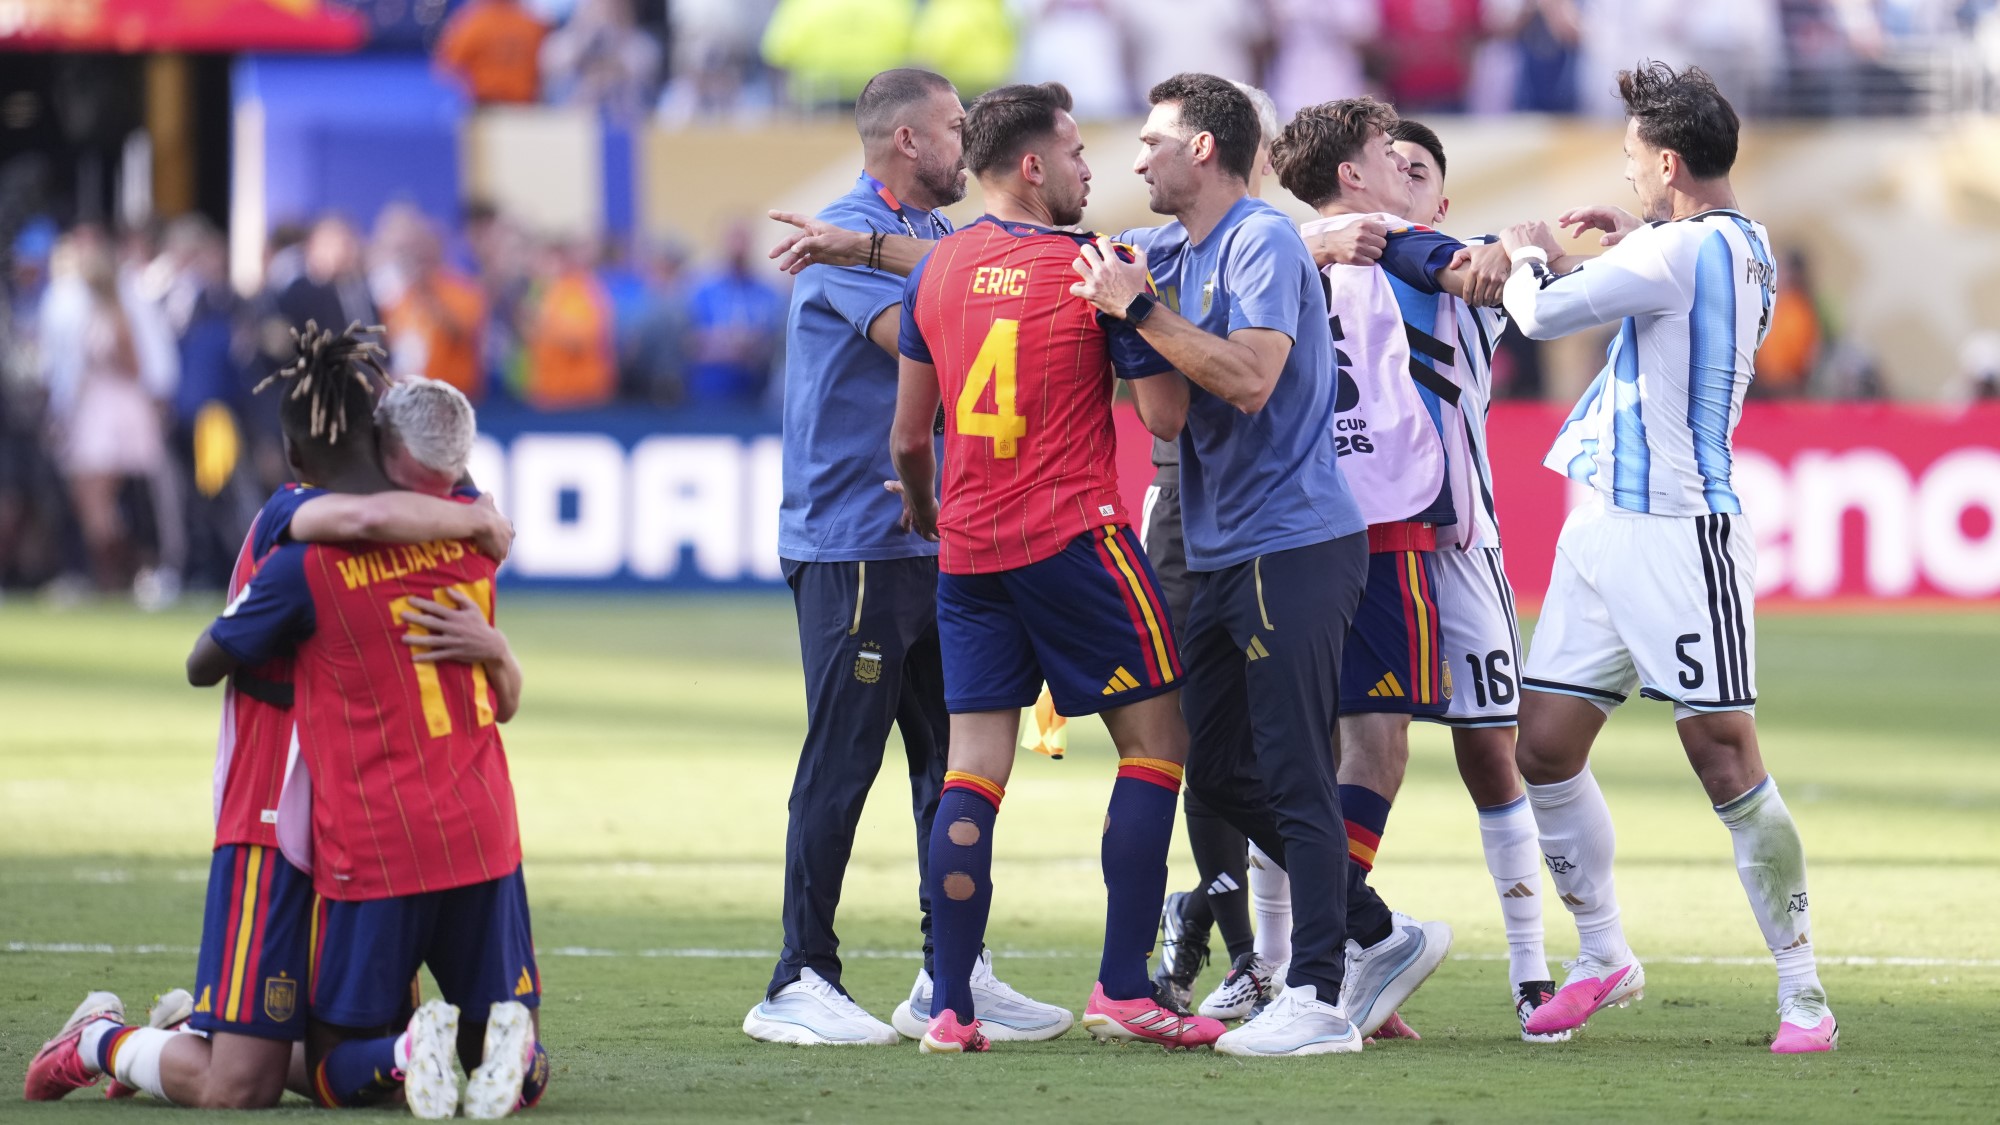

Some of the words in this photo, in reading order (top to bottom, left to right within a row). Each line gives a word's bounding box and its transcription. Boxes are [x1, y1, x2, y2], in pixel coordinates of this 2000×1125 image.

[972, 266, 1027, 296] ERIC
[956, 318, 1027, 459] 4
[1336, 418, 1367, 432] CUP
[1729, 446, 2000, 598] eno
[336, 538, 465, 591] WILLIAMS
[389, 577, 496, 739] 17
[1466, 650, 1515, 708] 16
[1675, 633, 1704, 689] 5
